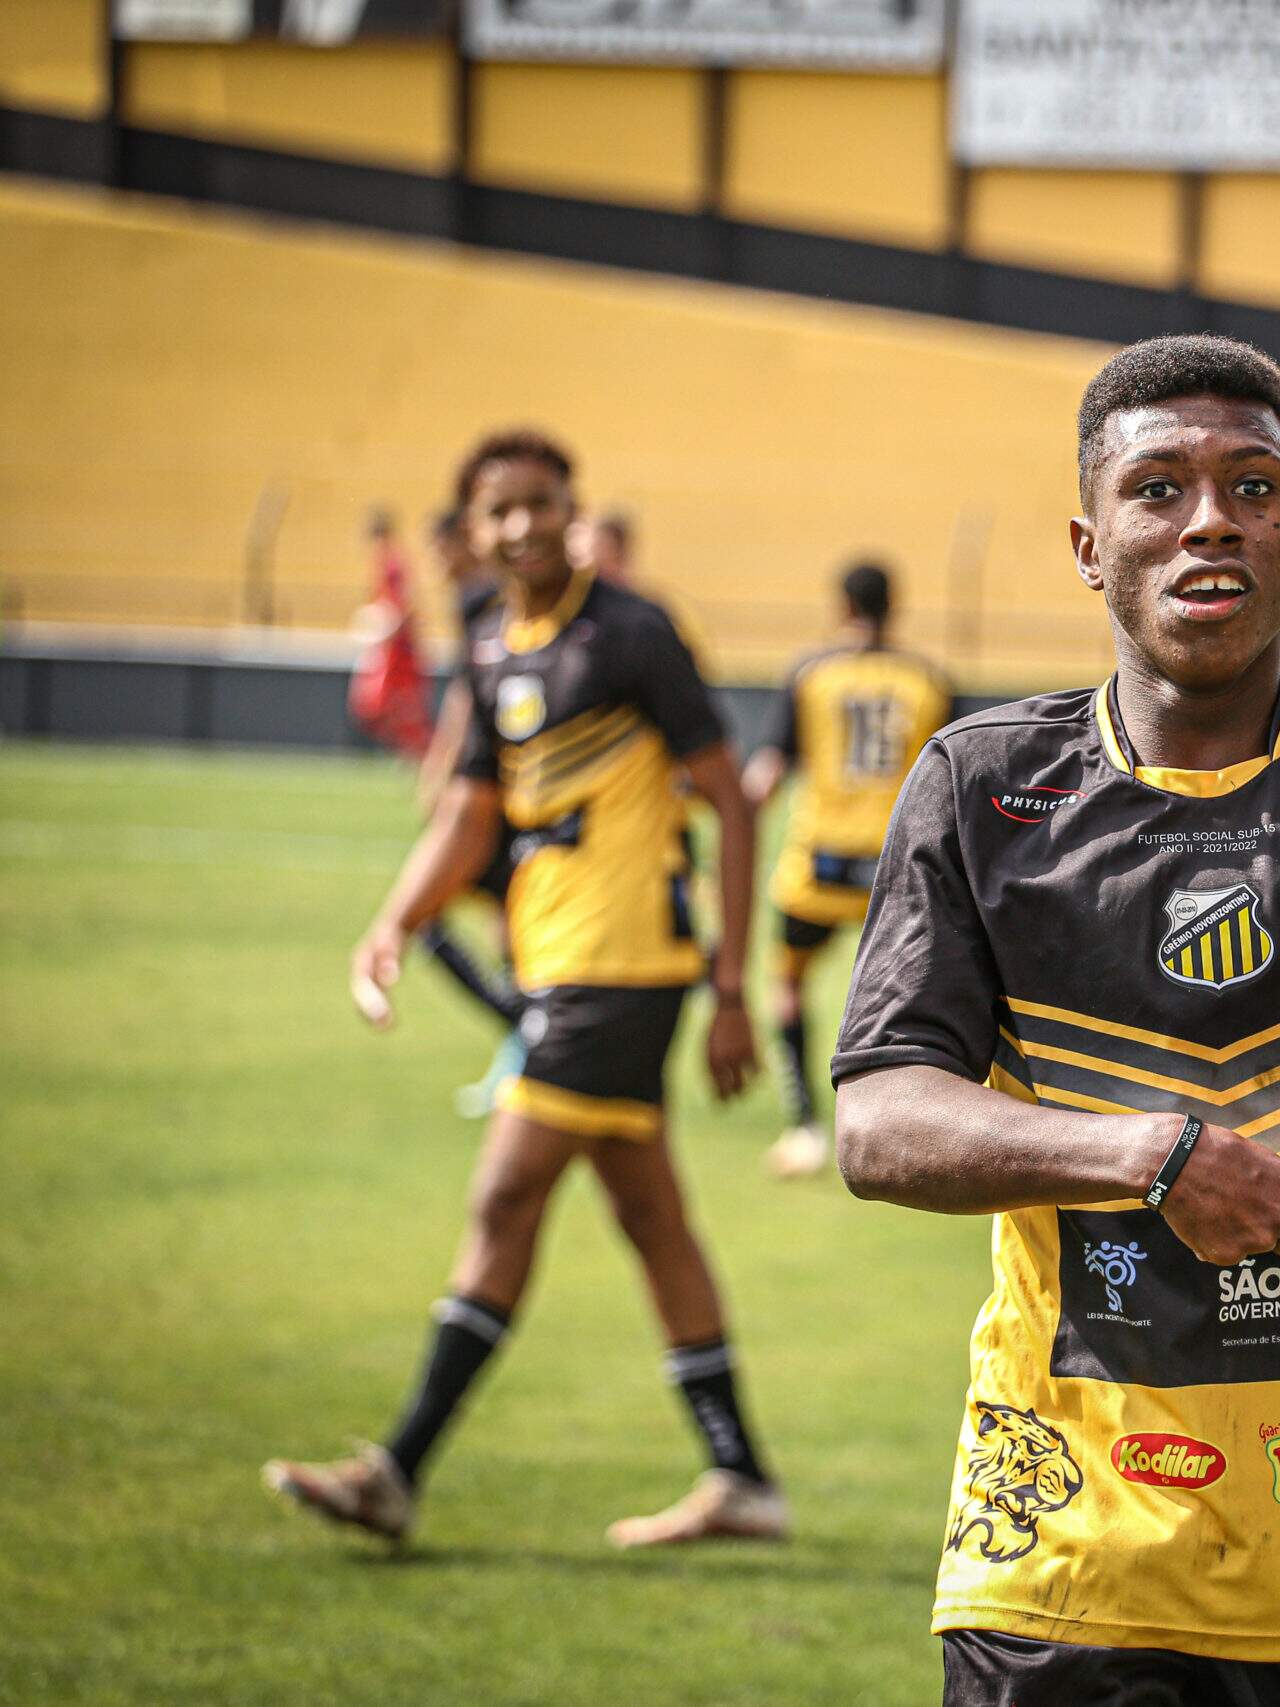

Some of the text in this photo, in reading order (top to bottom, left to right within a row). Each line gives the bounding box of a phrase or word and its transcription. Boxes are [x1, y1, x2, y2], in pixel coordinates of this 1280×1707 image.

[1001, 794, 1077, 811] PHYSICUS
[1138, 823, 1276, 845] FUTEBOL SOCIAL SUB-15
[1158, 844, 1184, 854] ANO
[1202, 840, 1257, 853] 2021/2022
[1191, 892, 1250, 935] NOVORIZONTINO
[1222, 1335, 1258, 1347] Secretaria
[1260, 1335, 1270, 1344] de
[1118, 1440, 1217, 1480] Kodilar
